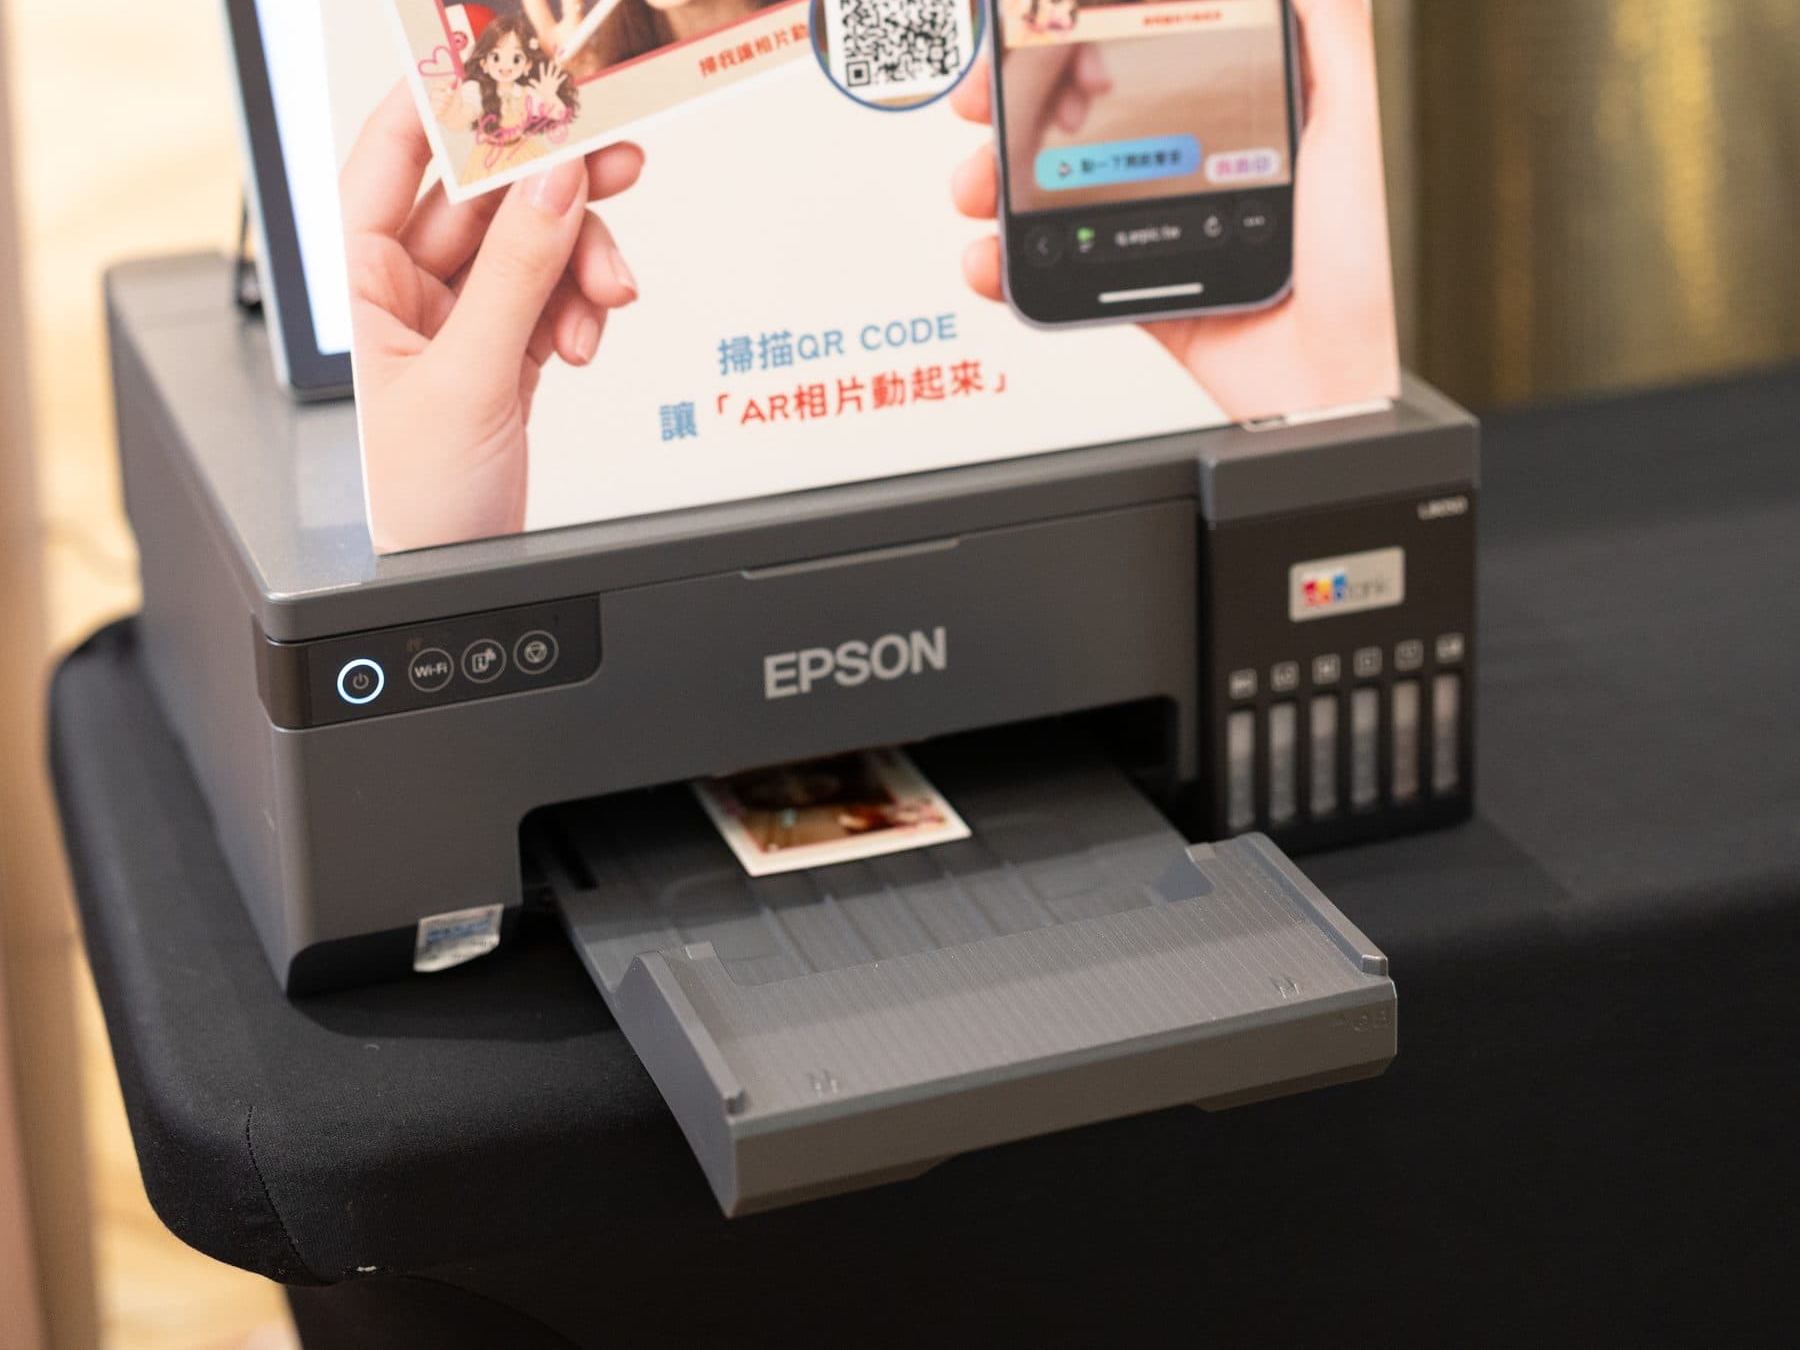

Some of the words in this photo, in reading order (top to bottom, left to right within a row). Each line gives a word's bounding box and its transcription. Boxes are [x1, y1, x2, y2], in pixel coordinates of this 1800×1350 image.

[717, 330, 845, 376] 掃描QR
[860, 313, 958, 352] CODE
[414, 661, 449, 679] Wi-Fi
[763, 626, 948, 700] EPSON
